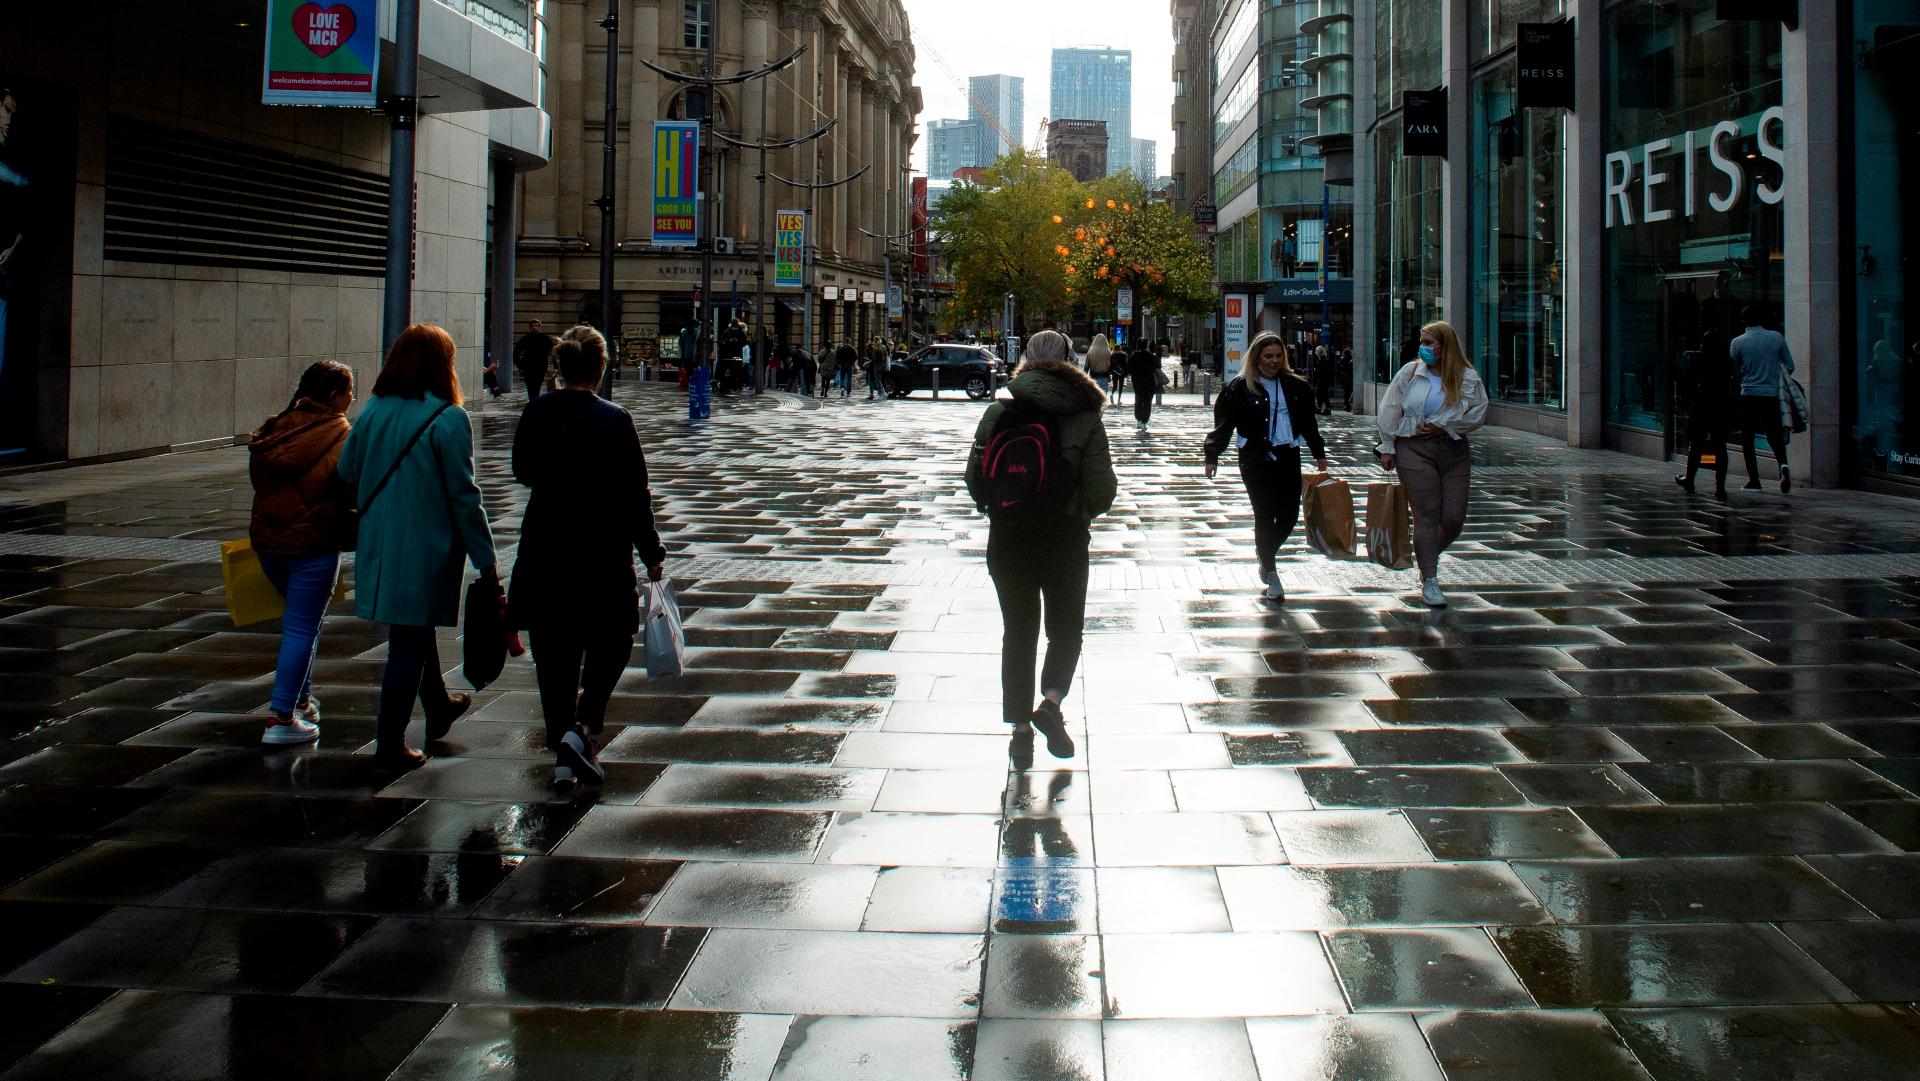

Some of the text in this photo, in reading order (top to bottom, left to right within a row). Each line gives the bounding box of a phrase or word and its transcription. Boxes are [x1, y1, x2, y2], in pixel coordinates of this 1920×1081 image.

[309, 12, 340, 29] LOVE
[308, 29, 338, 46] MCR
[1521, 69, 1564, 78] REISS
[272, 77, 369, 86] welcomebackmanchester.com
[1407, 124, 1439, 134] ZARA
[1605, 106, 1784, 229] REISS
[657, 203, 691, 214] GOOD TO
[656, 218, 692, 230] SEE YOU
[779, 214, 803, 230] YES
[778, 231, 802, 246] YES
[778, 247, 801, 262] YES
[728, 267, 734, 275] &
[1890, 450, 1904, 465] Stay
